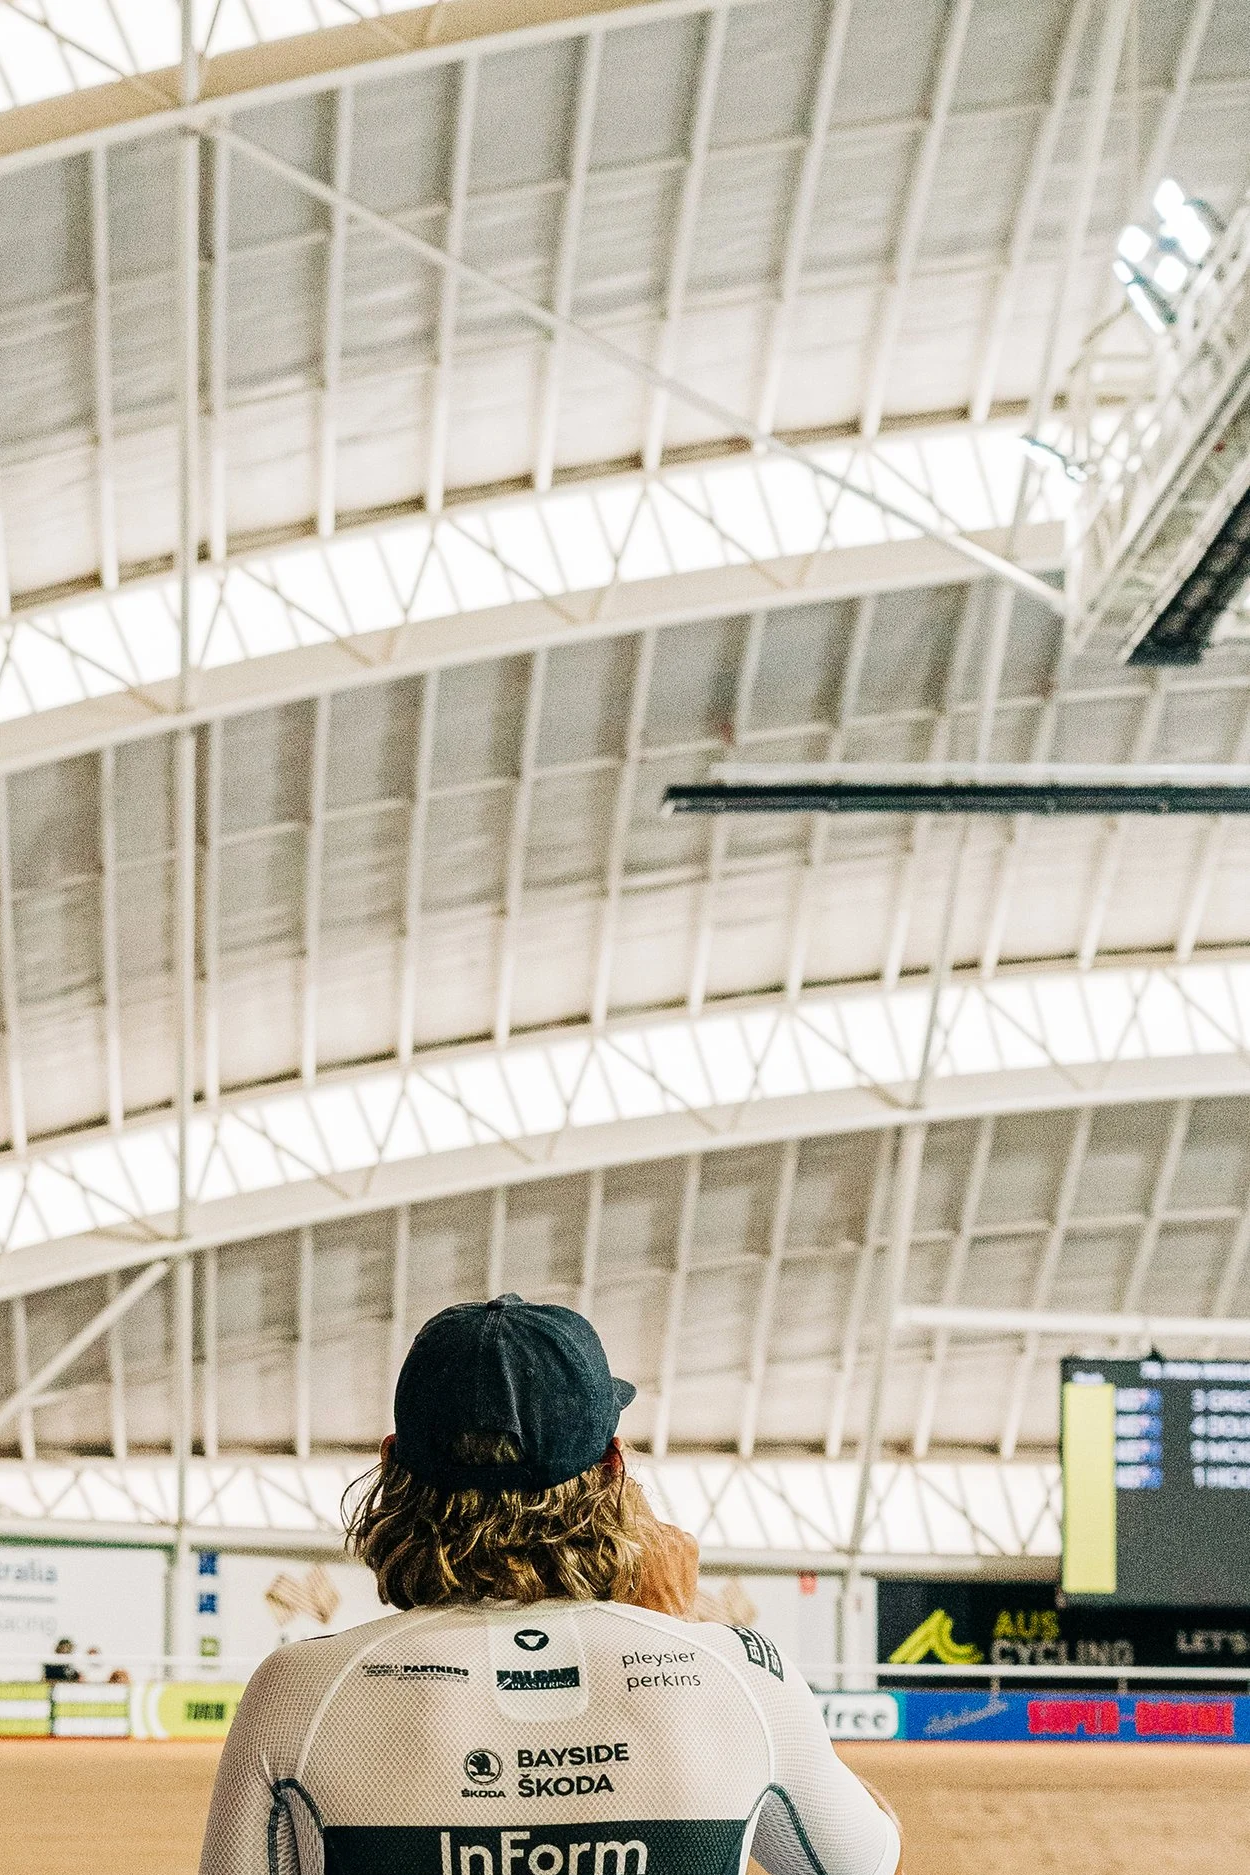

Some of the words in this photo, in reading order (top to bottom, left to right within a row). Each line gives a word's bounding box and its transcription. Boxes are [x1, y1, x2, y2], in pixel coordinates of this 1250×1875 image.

[993, 1610, 1061, 1640] AUS
[621, 1651, 696, 1668] pleysier
[990, 1639, 1135, 1665] CYCLING
[403, 1664, 469, 1677] PARTNERS
[626, 1672, 701, 1692] perkins
[517, 1743, 629, 1768] BAYSIDE
[461, 1788, 507, 1799] ŠKODA
[517, 1774, 615, 1798] ŠKODA
